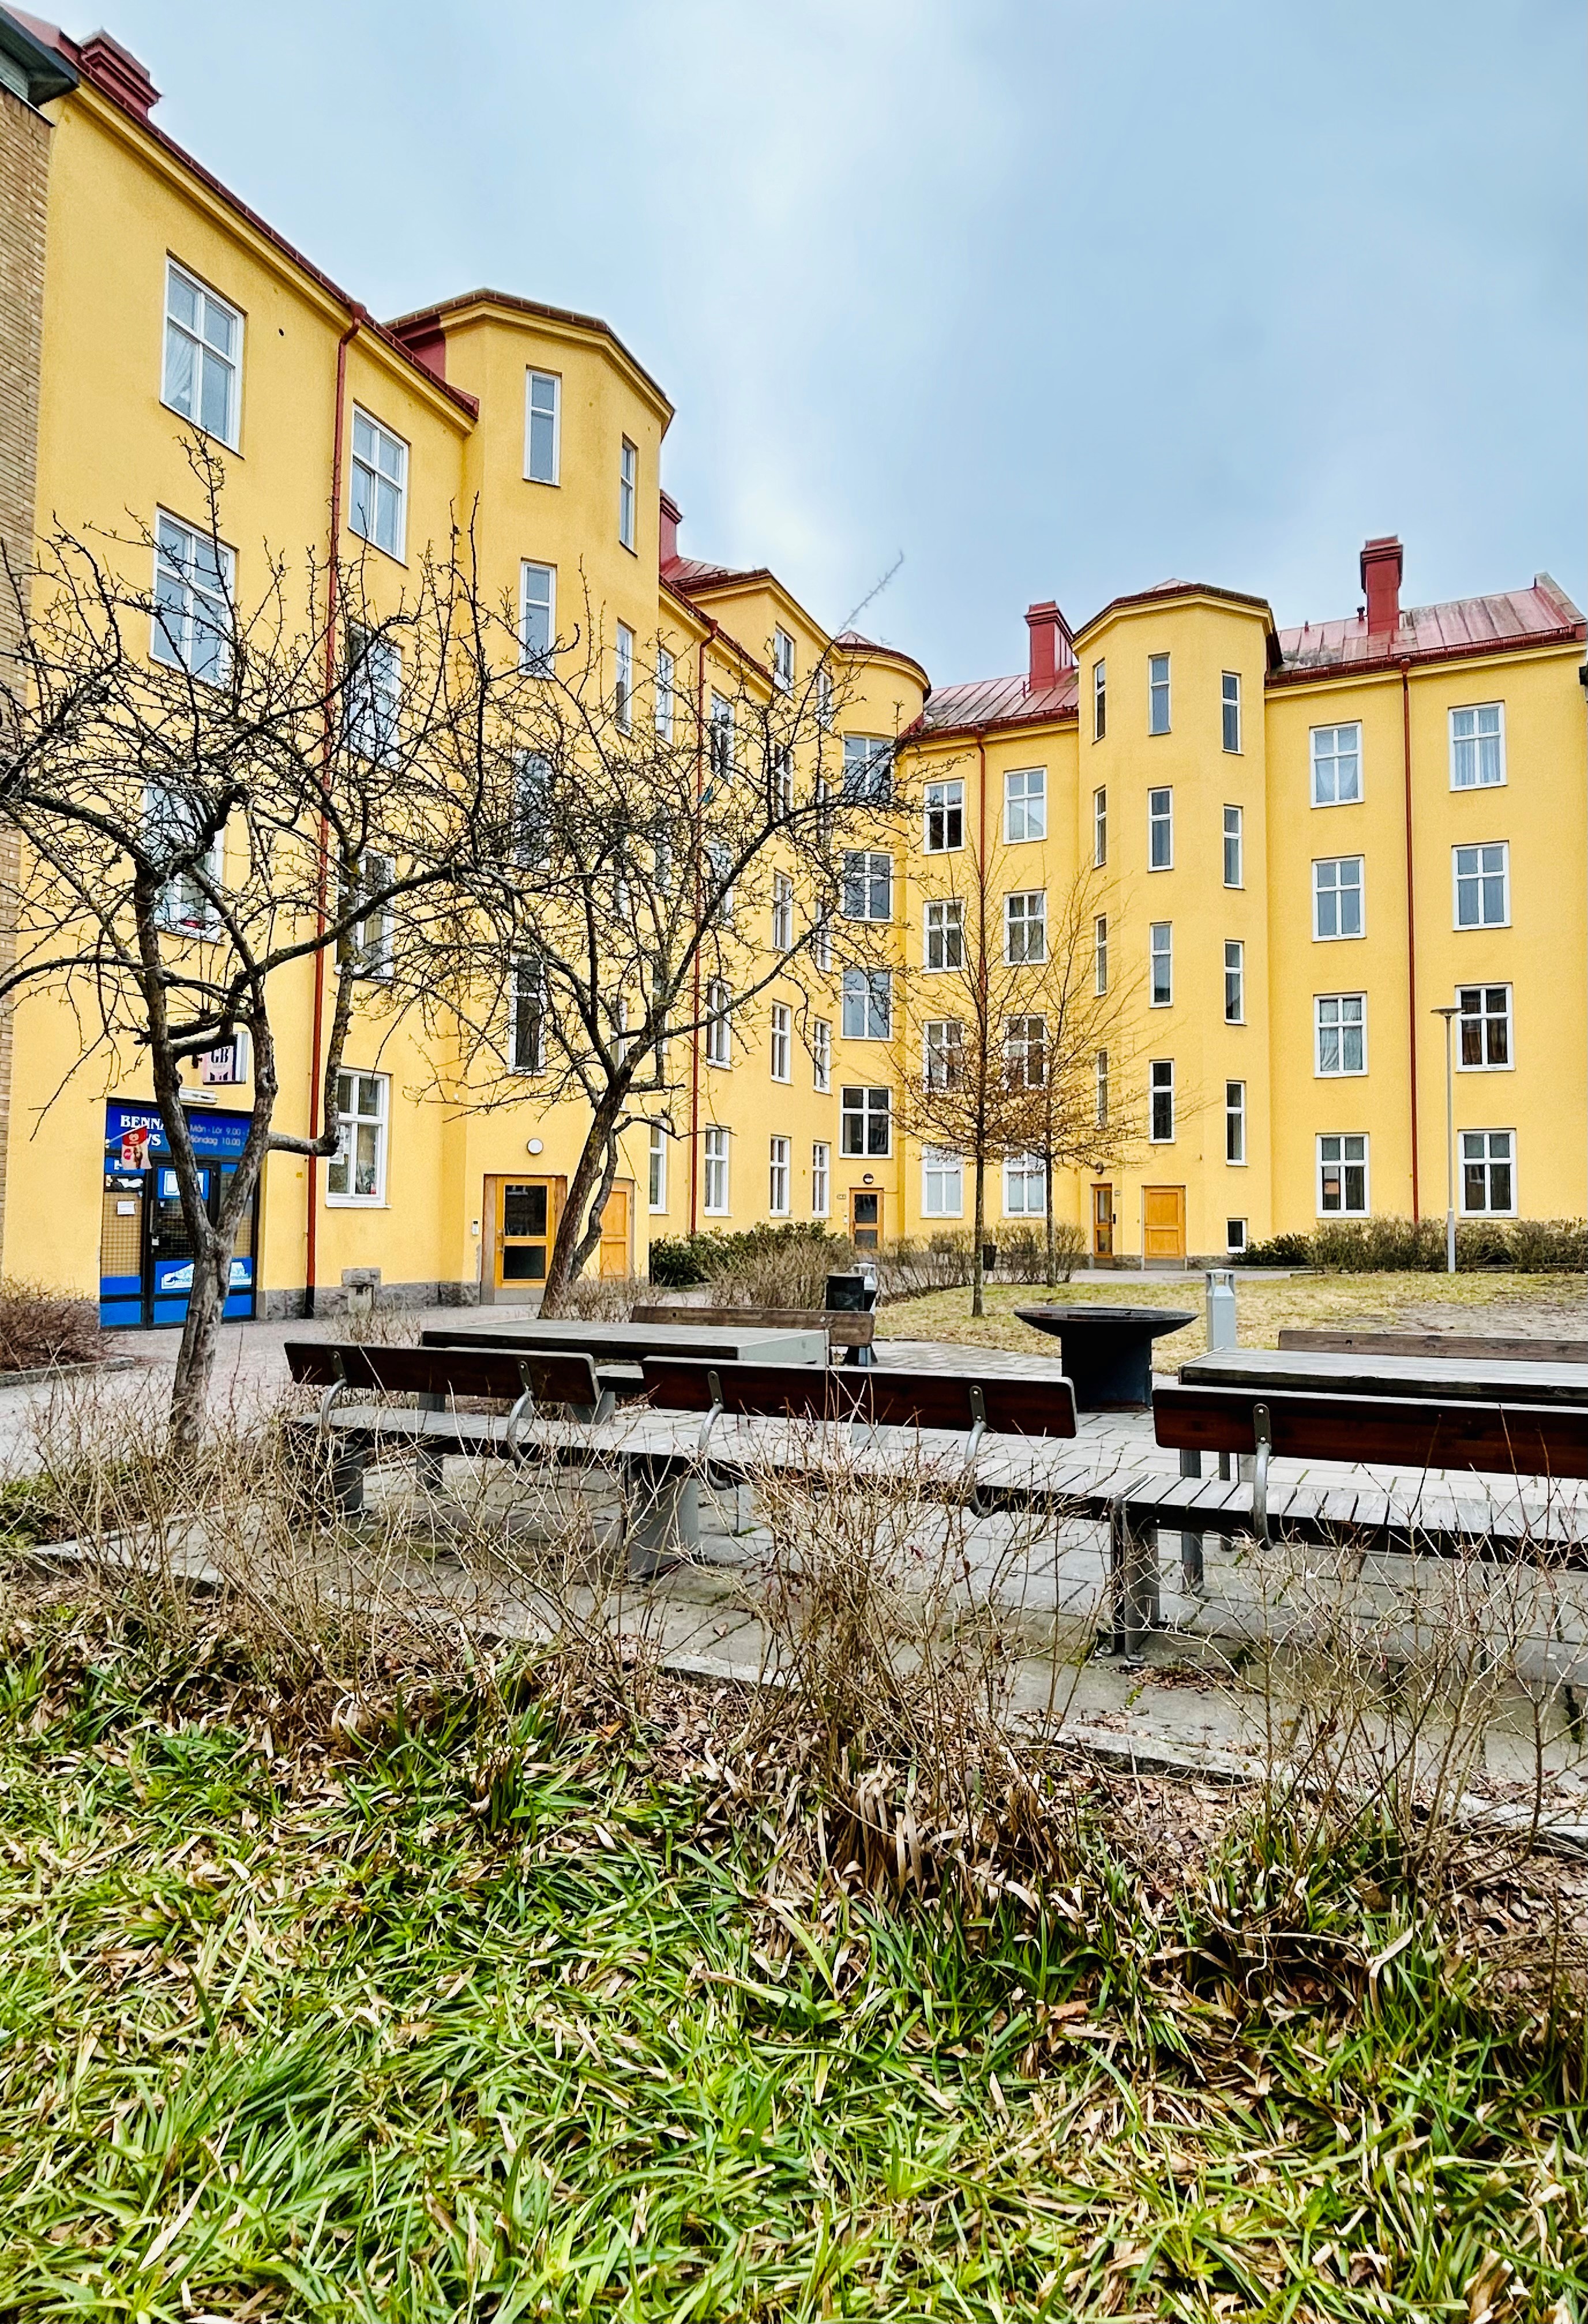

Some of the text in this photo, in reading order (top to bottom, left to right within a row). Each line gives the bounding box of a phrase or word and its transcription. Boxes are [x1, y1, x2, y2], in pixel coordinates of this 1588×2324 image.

[211, 1048, 228, 1063] GB
[120, 1114, 164, 1131] BENN
[222, 1137, 241, 1147] 10.00
